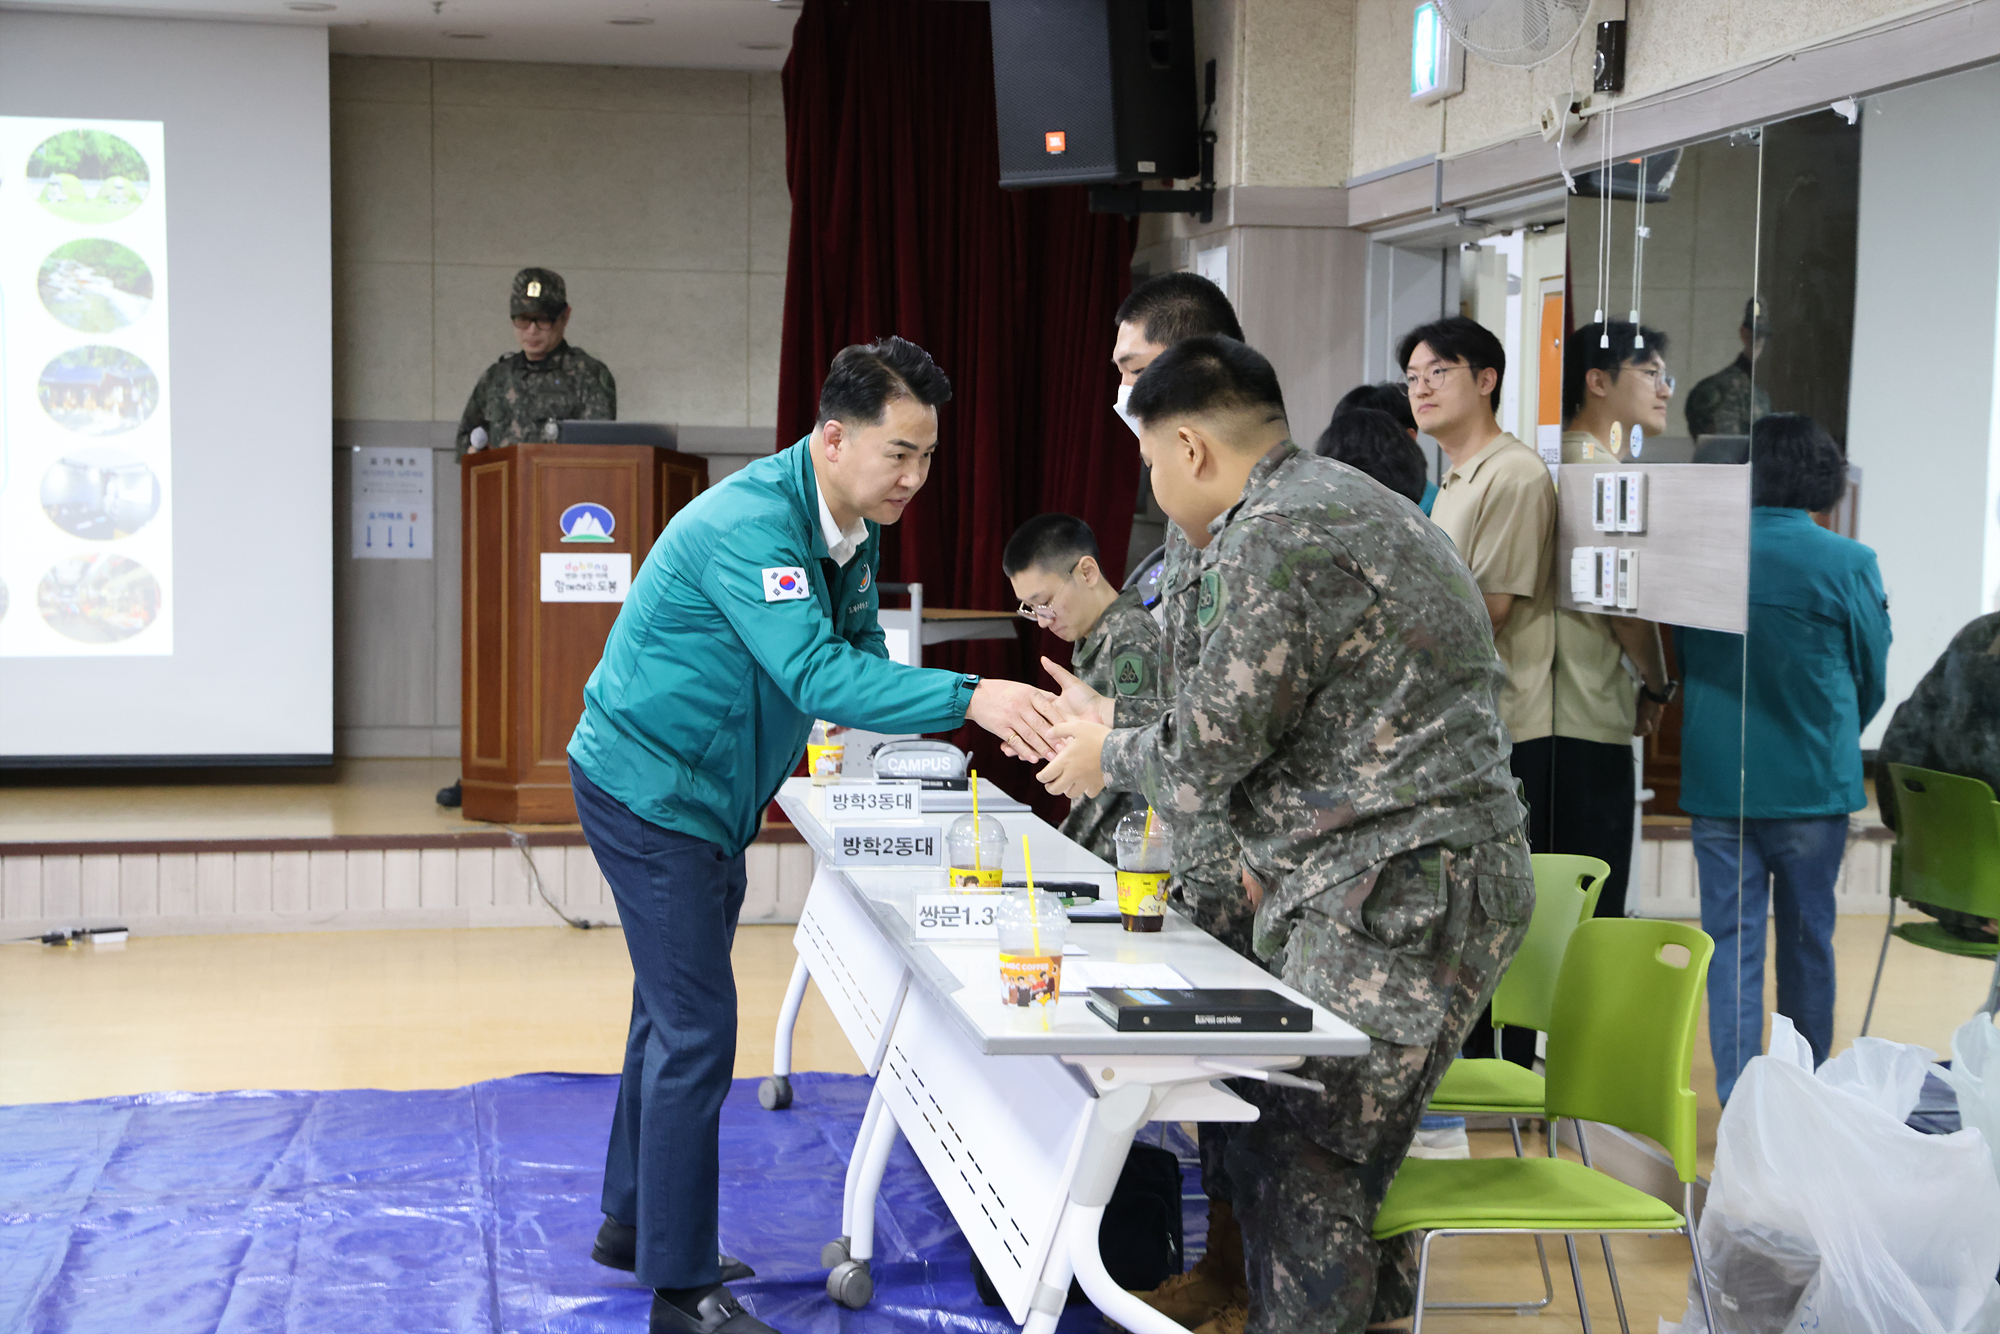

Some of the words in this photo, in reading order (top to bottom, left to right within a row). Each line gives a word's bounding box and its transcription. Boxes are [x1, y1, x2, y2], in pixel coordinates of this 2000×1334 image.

[887, 757, 951, 772] CAMPUS
[833, 793, 912, 811] 방학3동대
[843, 836, 933, 856] 방학2동대
[918, 904, 1000, 928] 쌍문1.3
[1021, 963, 1050, 971] COFFEE
